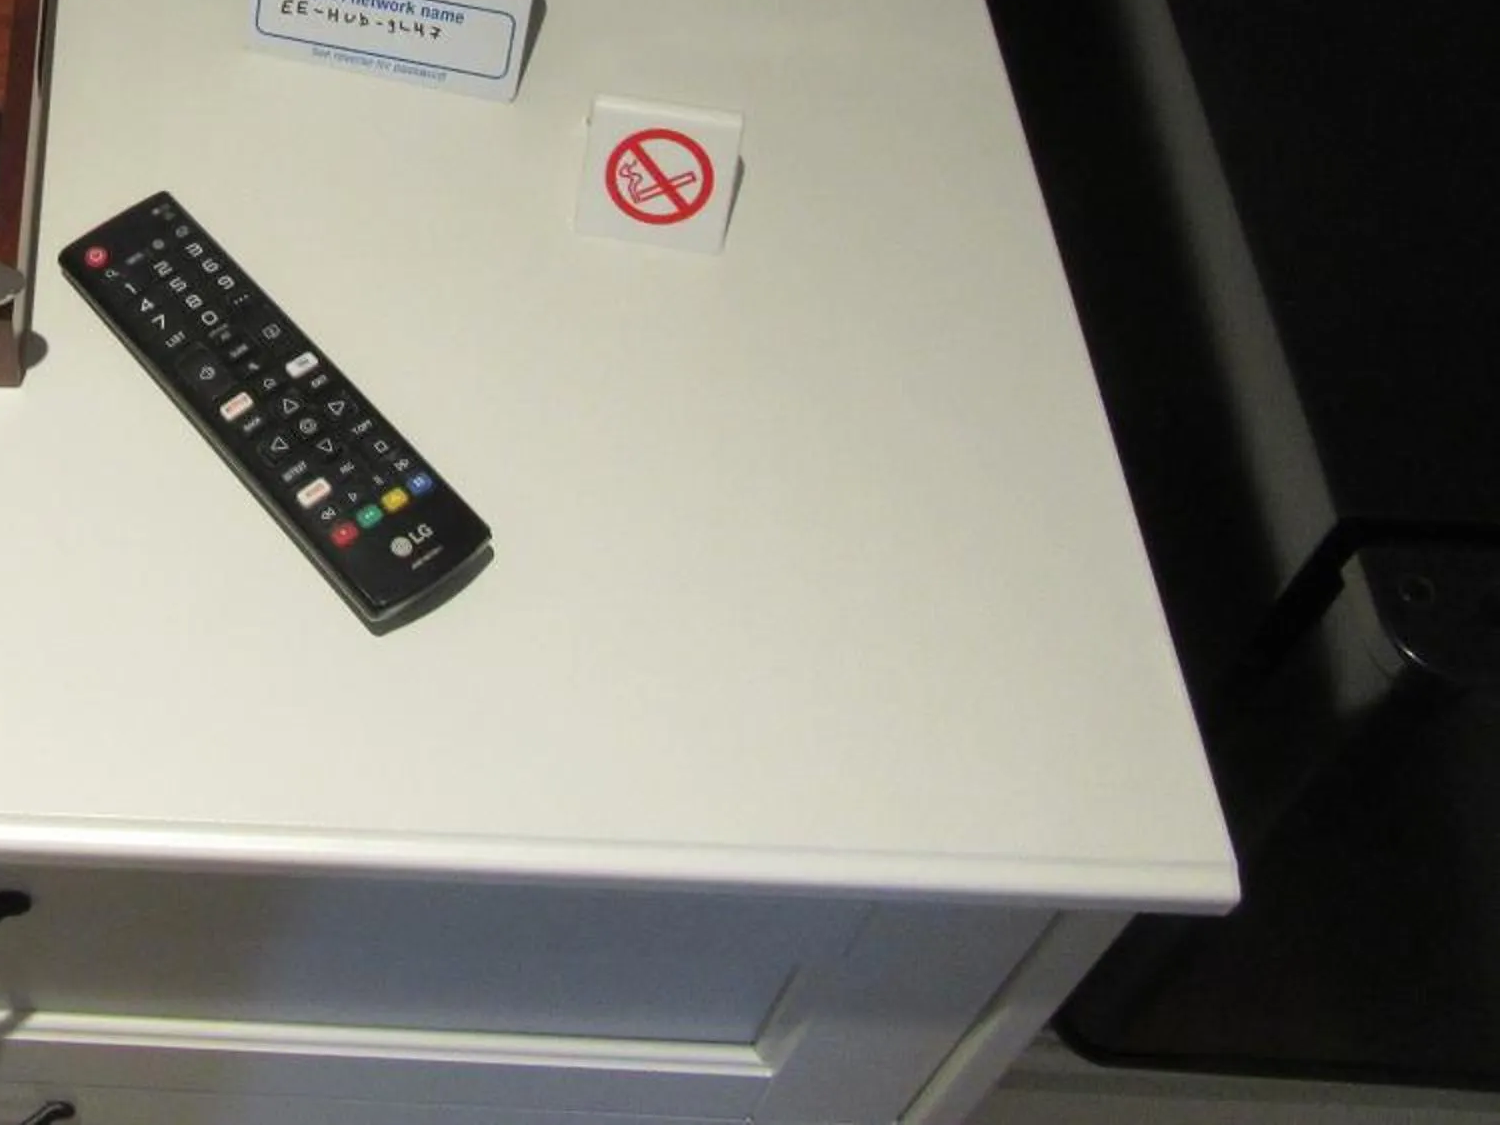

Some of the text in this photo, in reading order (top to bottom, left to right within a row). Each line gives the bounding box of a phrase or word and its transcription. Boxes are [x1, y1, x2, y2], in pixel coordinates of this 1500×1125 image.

[420, 5, 465, 24] name
[153, 260, 174, 277] 2
[201, 258, 220, 274] 6
[124, 282, 138, 295] 1
[217, 275, 236, 291] 9
[140, 297, 156, 313] 4
[185, 294, 204, 310] 8
[151, 314, 166, 330] 7
[408, 523, 434, 544] LG
